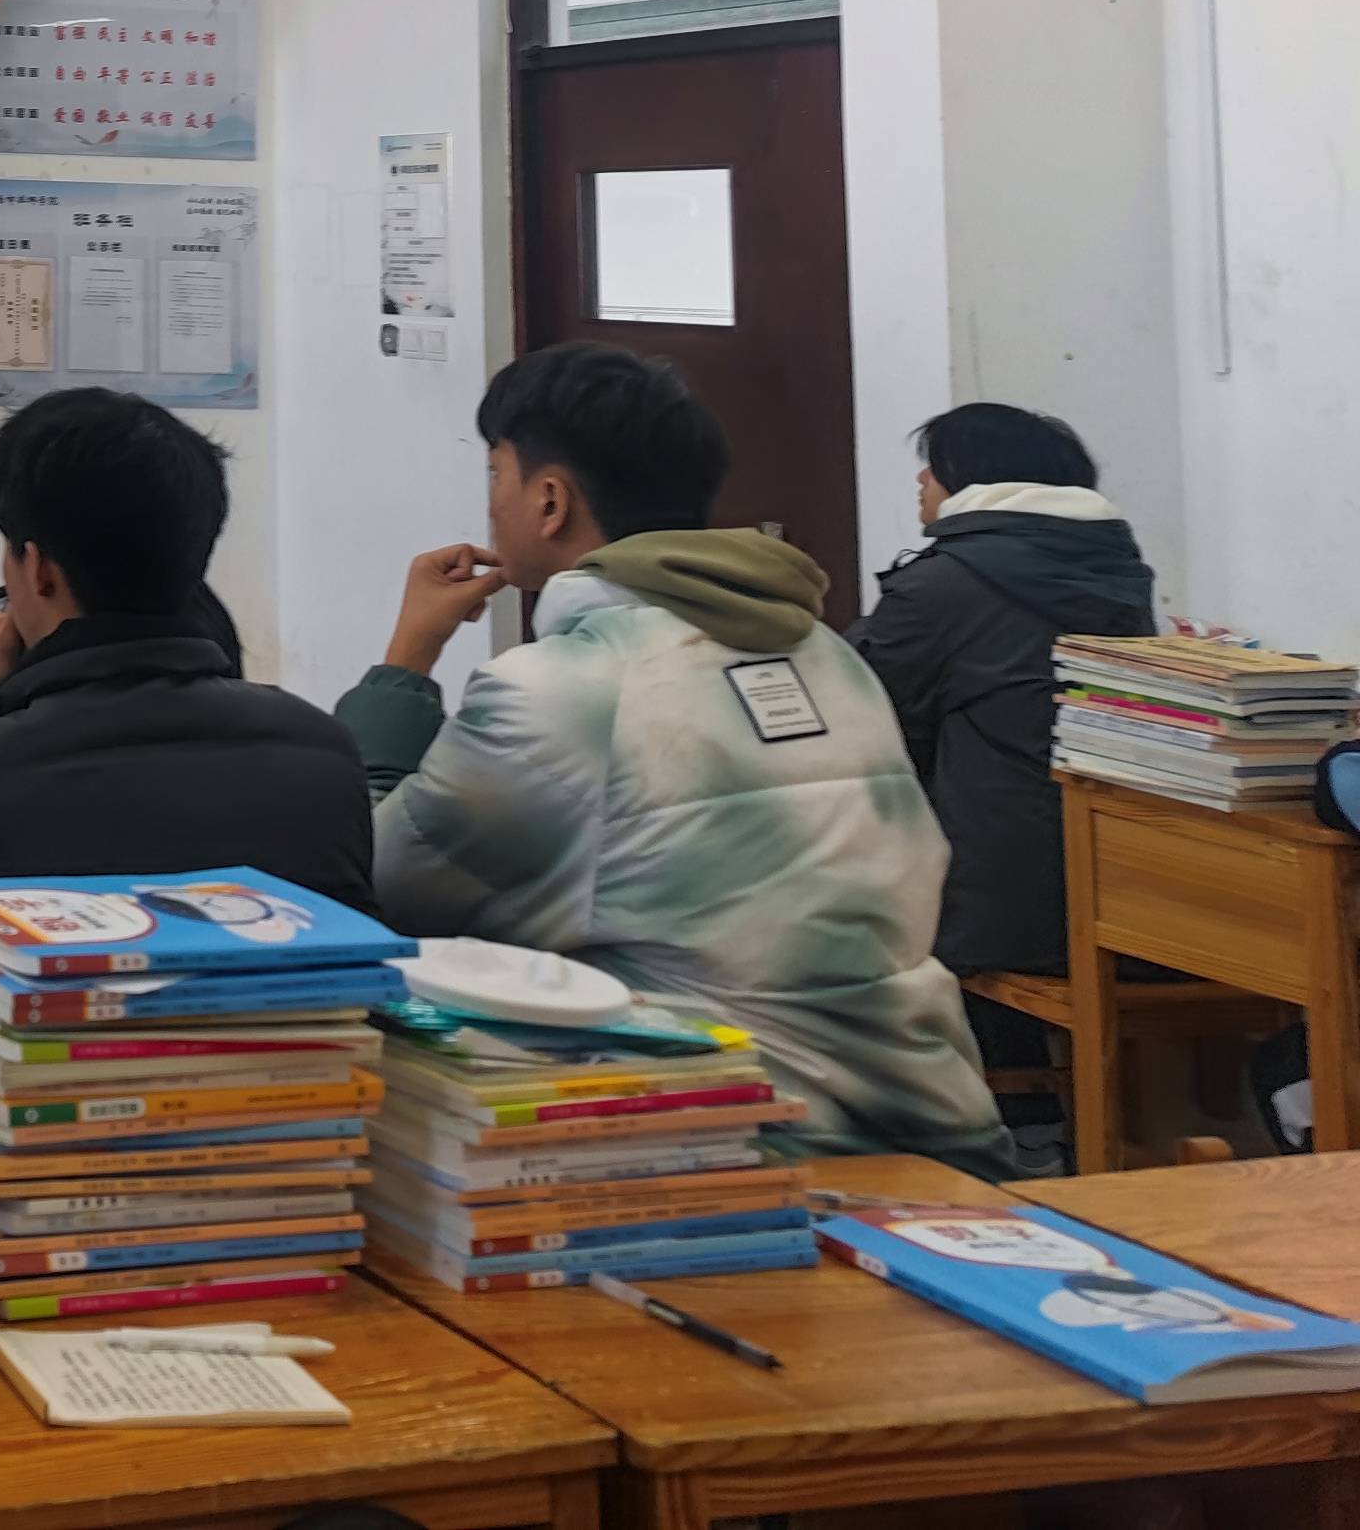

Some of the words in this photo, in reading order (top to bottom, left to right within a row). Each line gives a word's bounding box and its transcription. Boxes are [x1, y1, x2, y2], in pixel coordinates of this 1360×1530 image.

[96, 27, 128, 43] 民主
[141, 29, 174, 45] 文明
[183, 31, 217, 46] 和谐
[54, 66, 87, 81] 自由
[96, 67, 130, 85] 平等
[141, 70, 174, 85] 公正
[185, 72, 217, 87] 法治
[53, 106, 85, 124] 爱国
[96, 108, 131, 124] 敬业
[140, 111, 176, 127] 诚信
[184, 112, 217, 129] 友善
